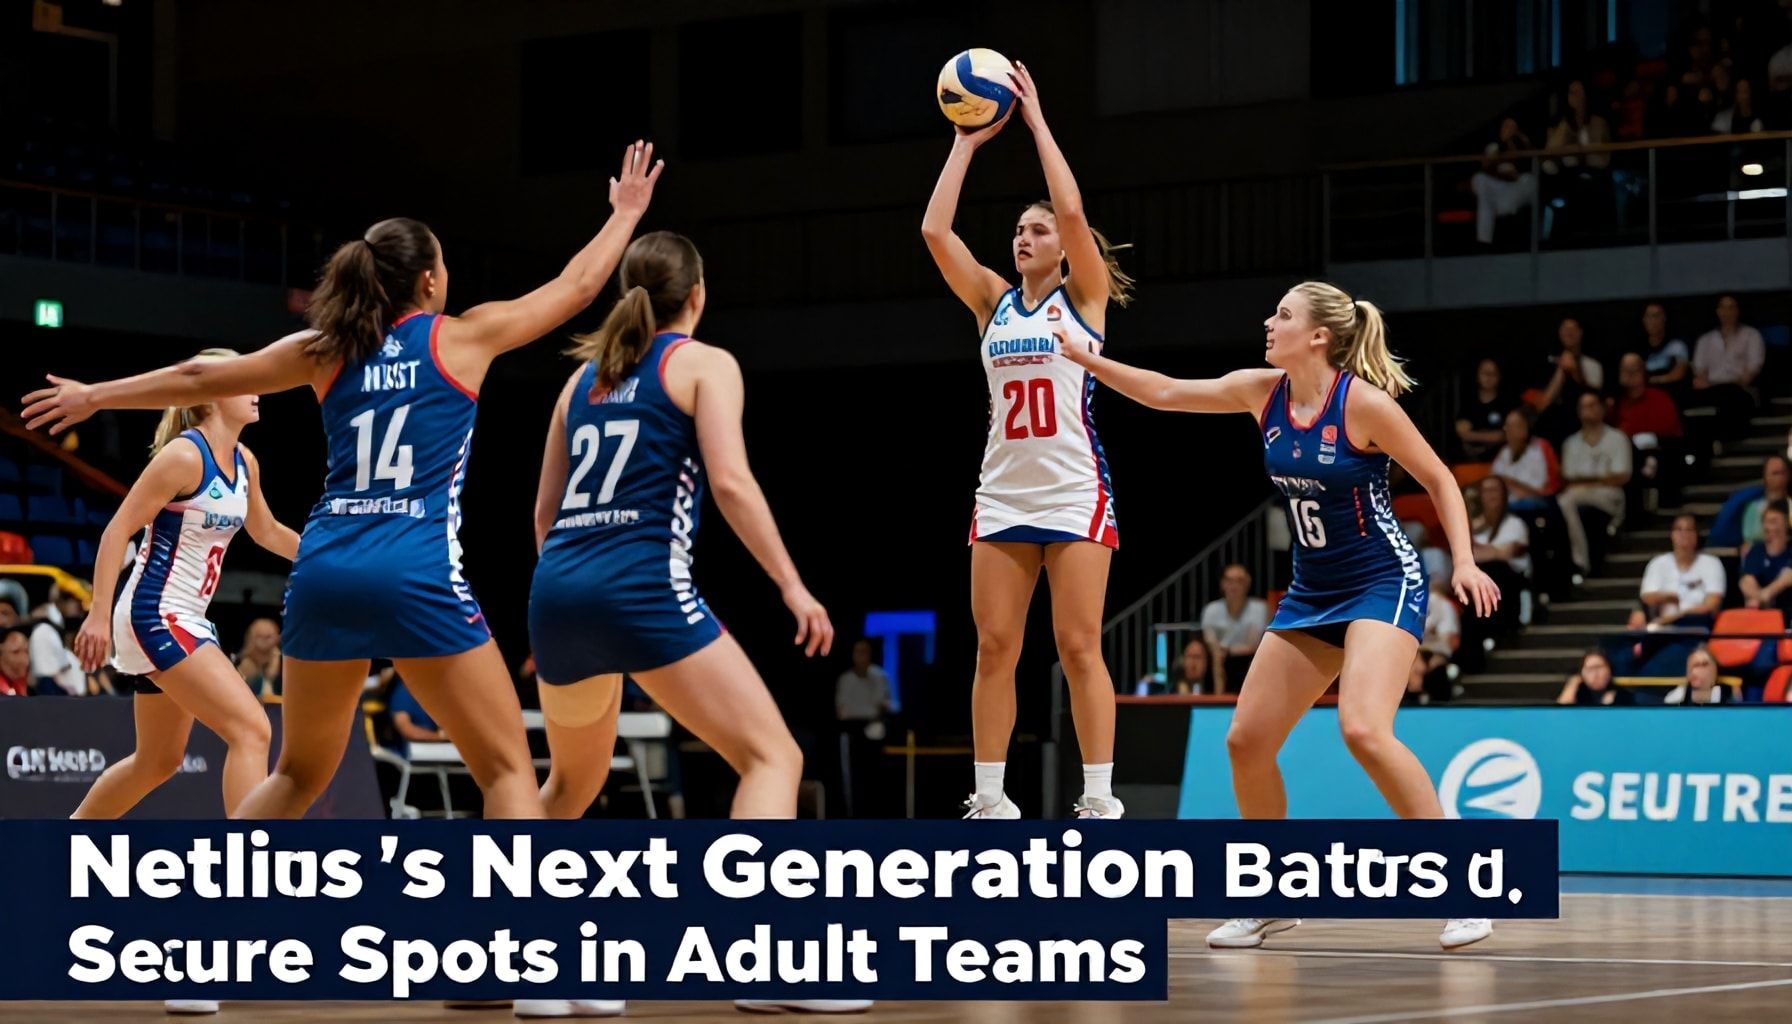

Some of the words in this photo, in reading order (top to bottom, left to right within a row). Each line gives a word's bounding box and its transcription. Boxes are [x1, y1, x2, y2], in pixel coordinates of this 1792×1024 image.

[350, 404, 414, 492] 14
[1003, 377, 1058, 440] 20
[561, 419, 640, 510] 27
